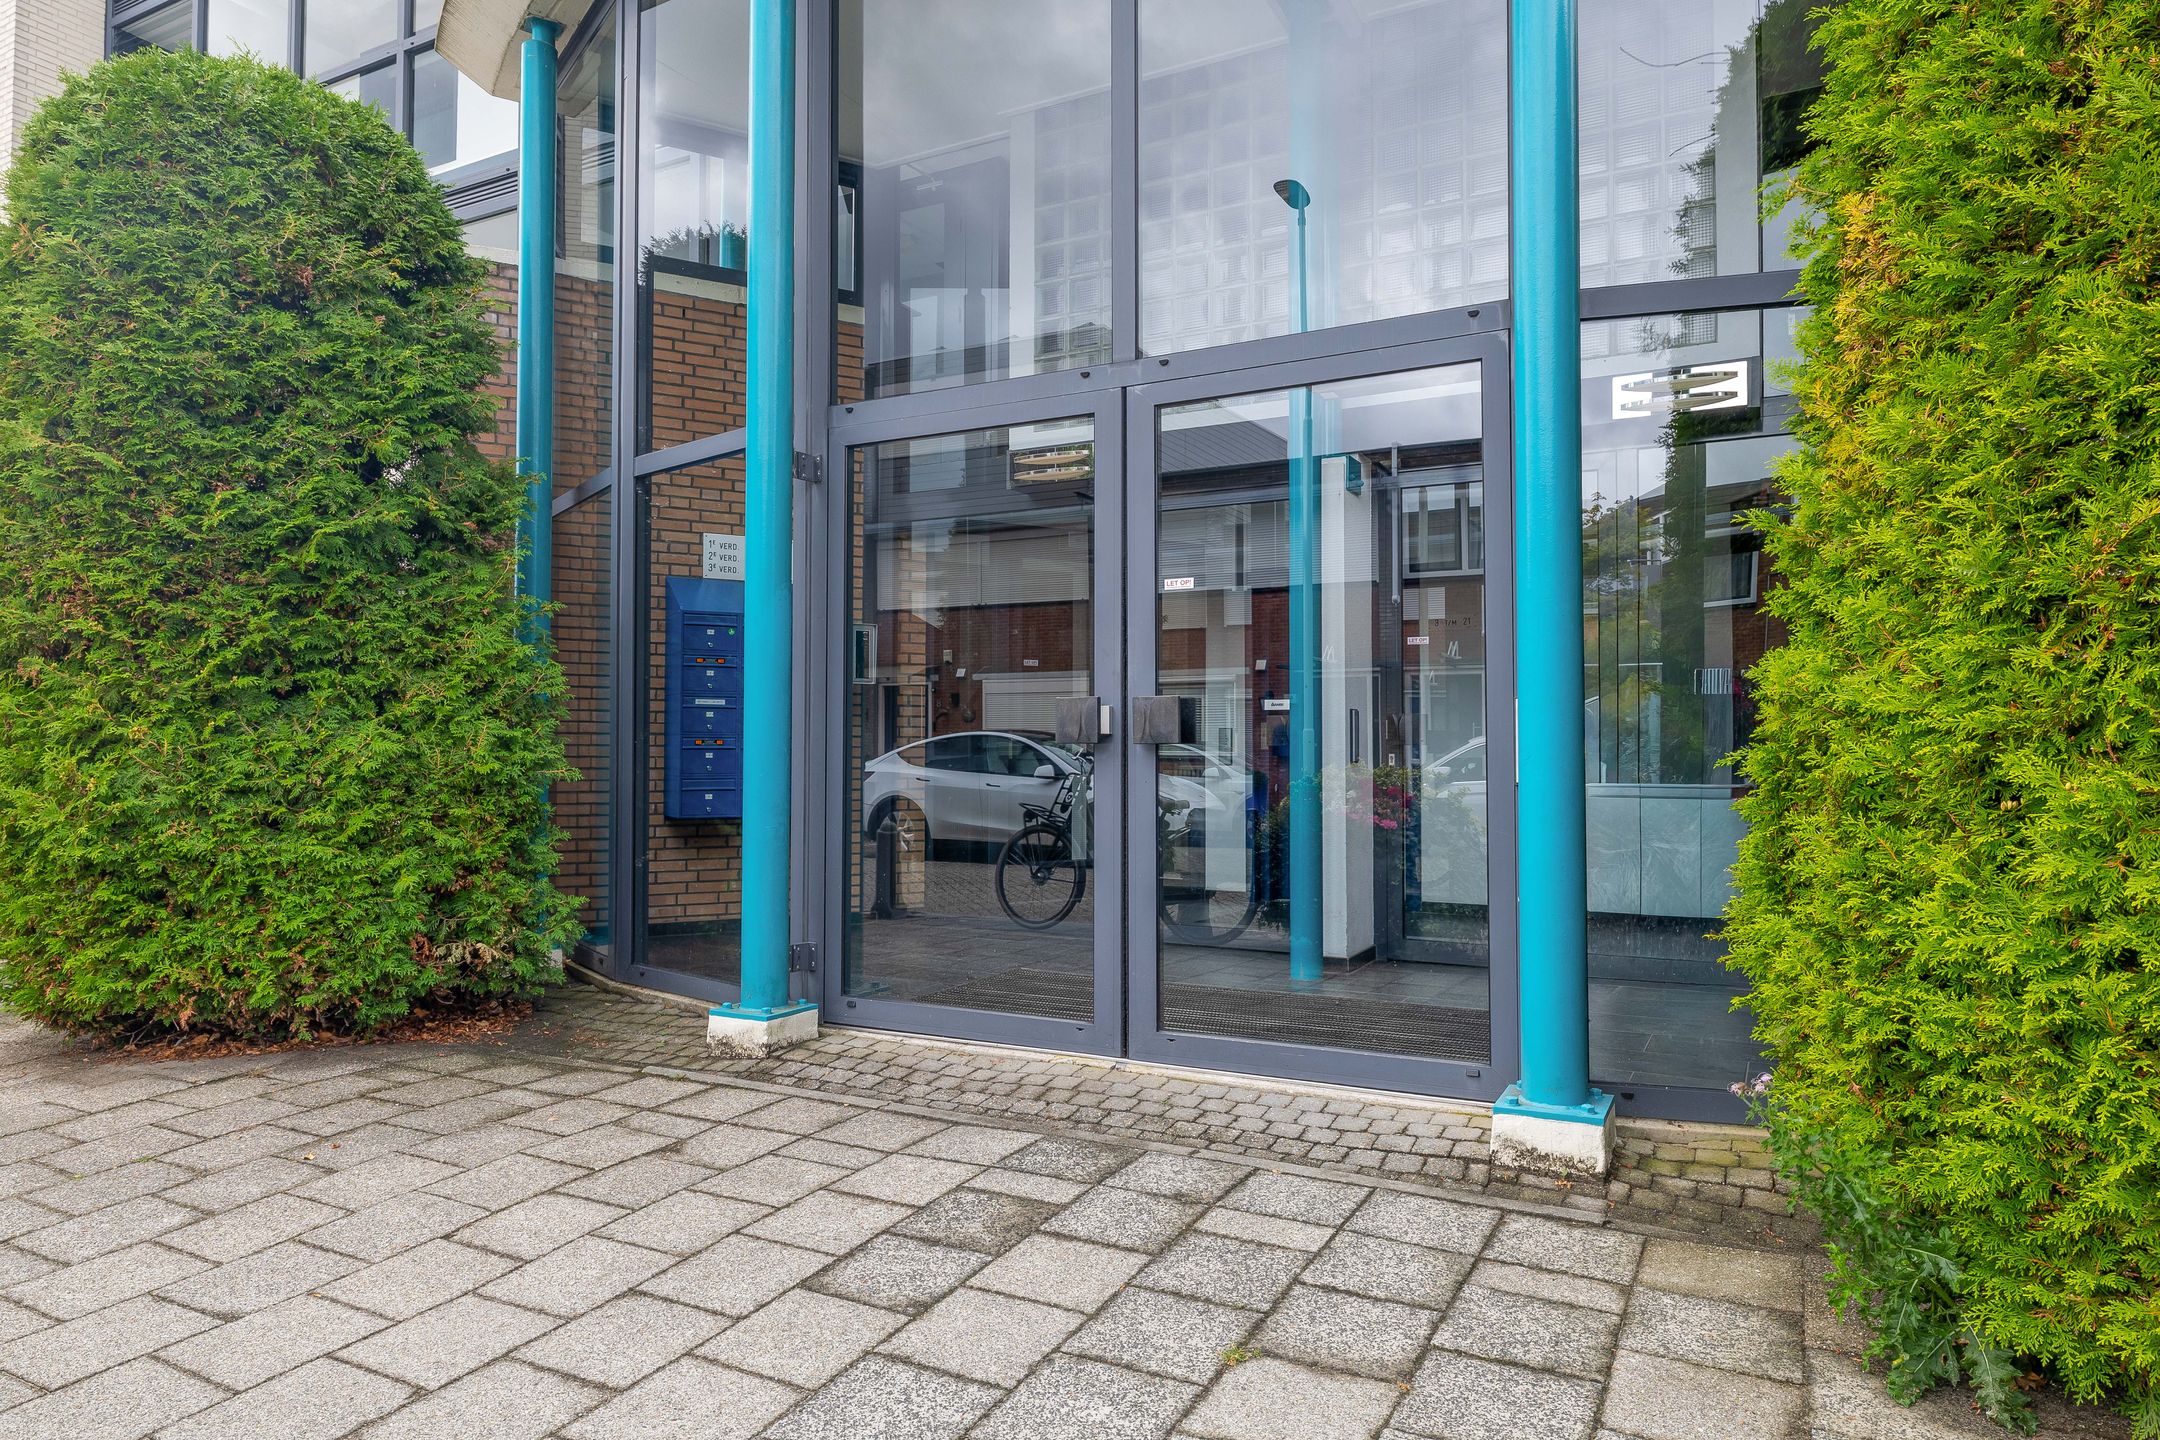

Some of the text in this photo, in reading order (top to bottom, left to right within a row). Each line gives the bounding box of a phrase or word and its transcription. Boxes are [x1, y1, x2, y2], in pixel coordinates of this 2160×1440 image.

[719, 542, 740, 551] VERD.
[719, 554, 740, 562] VERD.
[719, 566, 740, 574] VERD.
